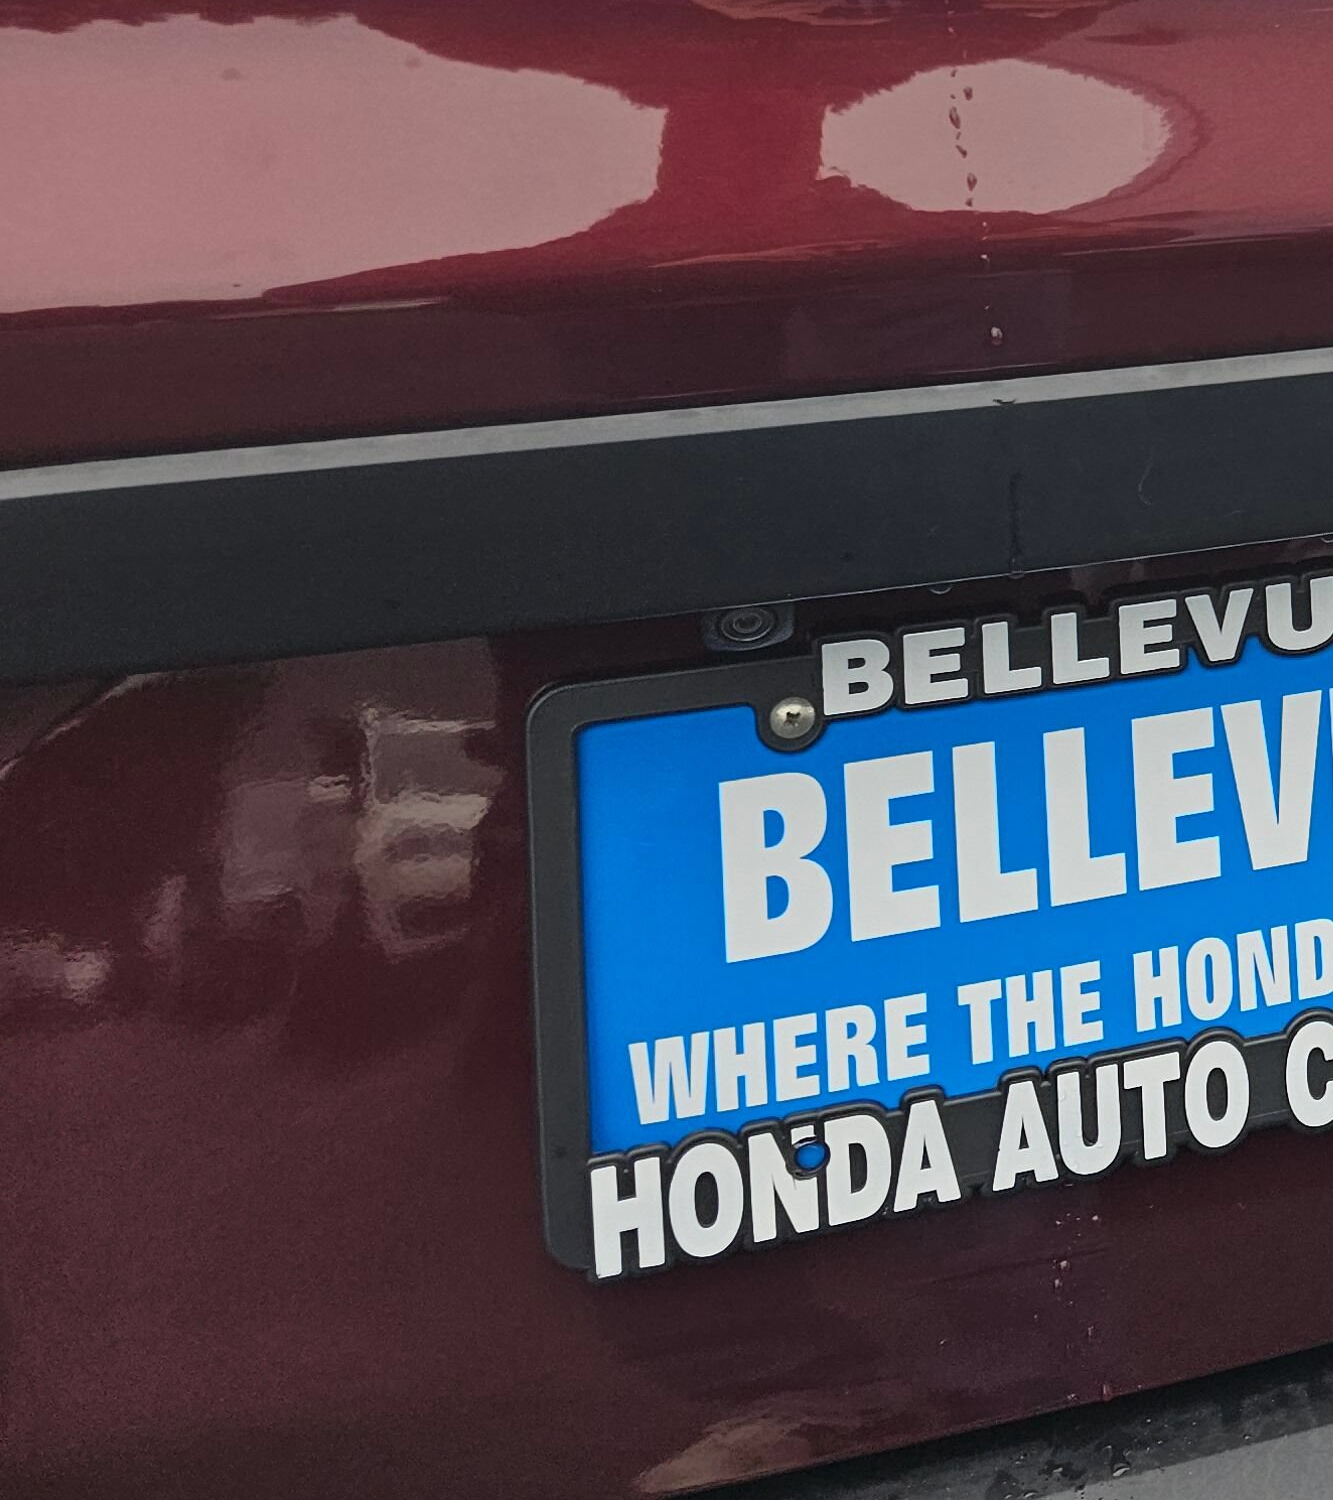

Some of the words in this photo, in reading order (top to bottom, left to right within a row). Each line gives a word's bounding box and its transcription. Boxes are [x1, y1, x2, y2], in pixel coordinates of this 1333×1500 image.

[628, 993, 930, 1125] WHERE
[957, 960, 1104, 1066] THE
[590, 1099, 963, 1279] HONDA
[992, 1040, 1250, 1192] AUTO
